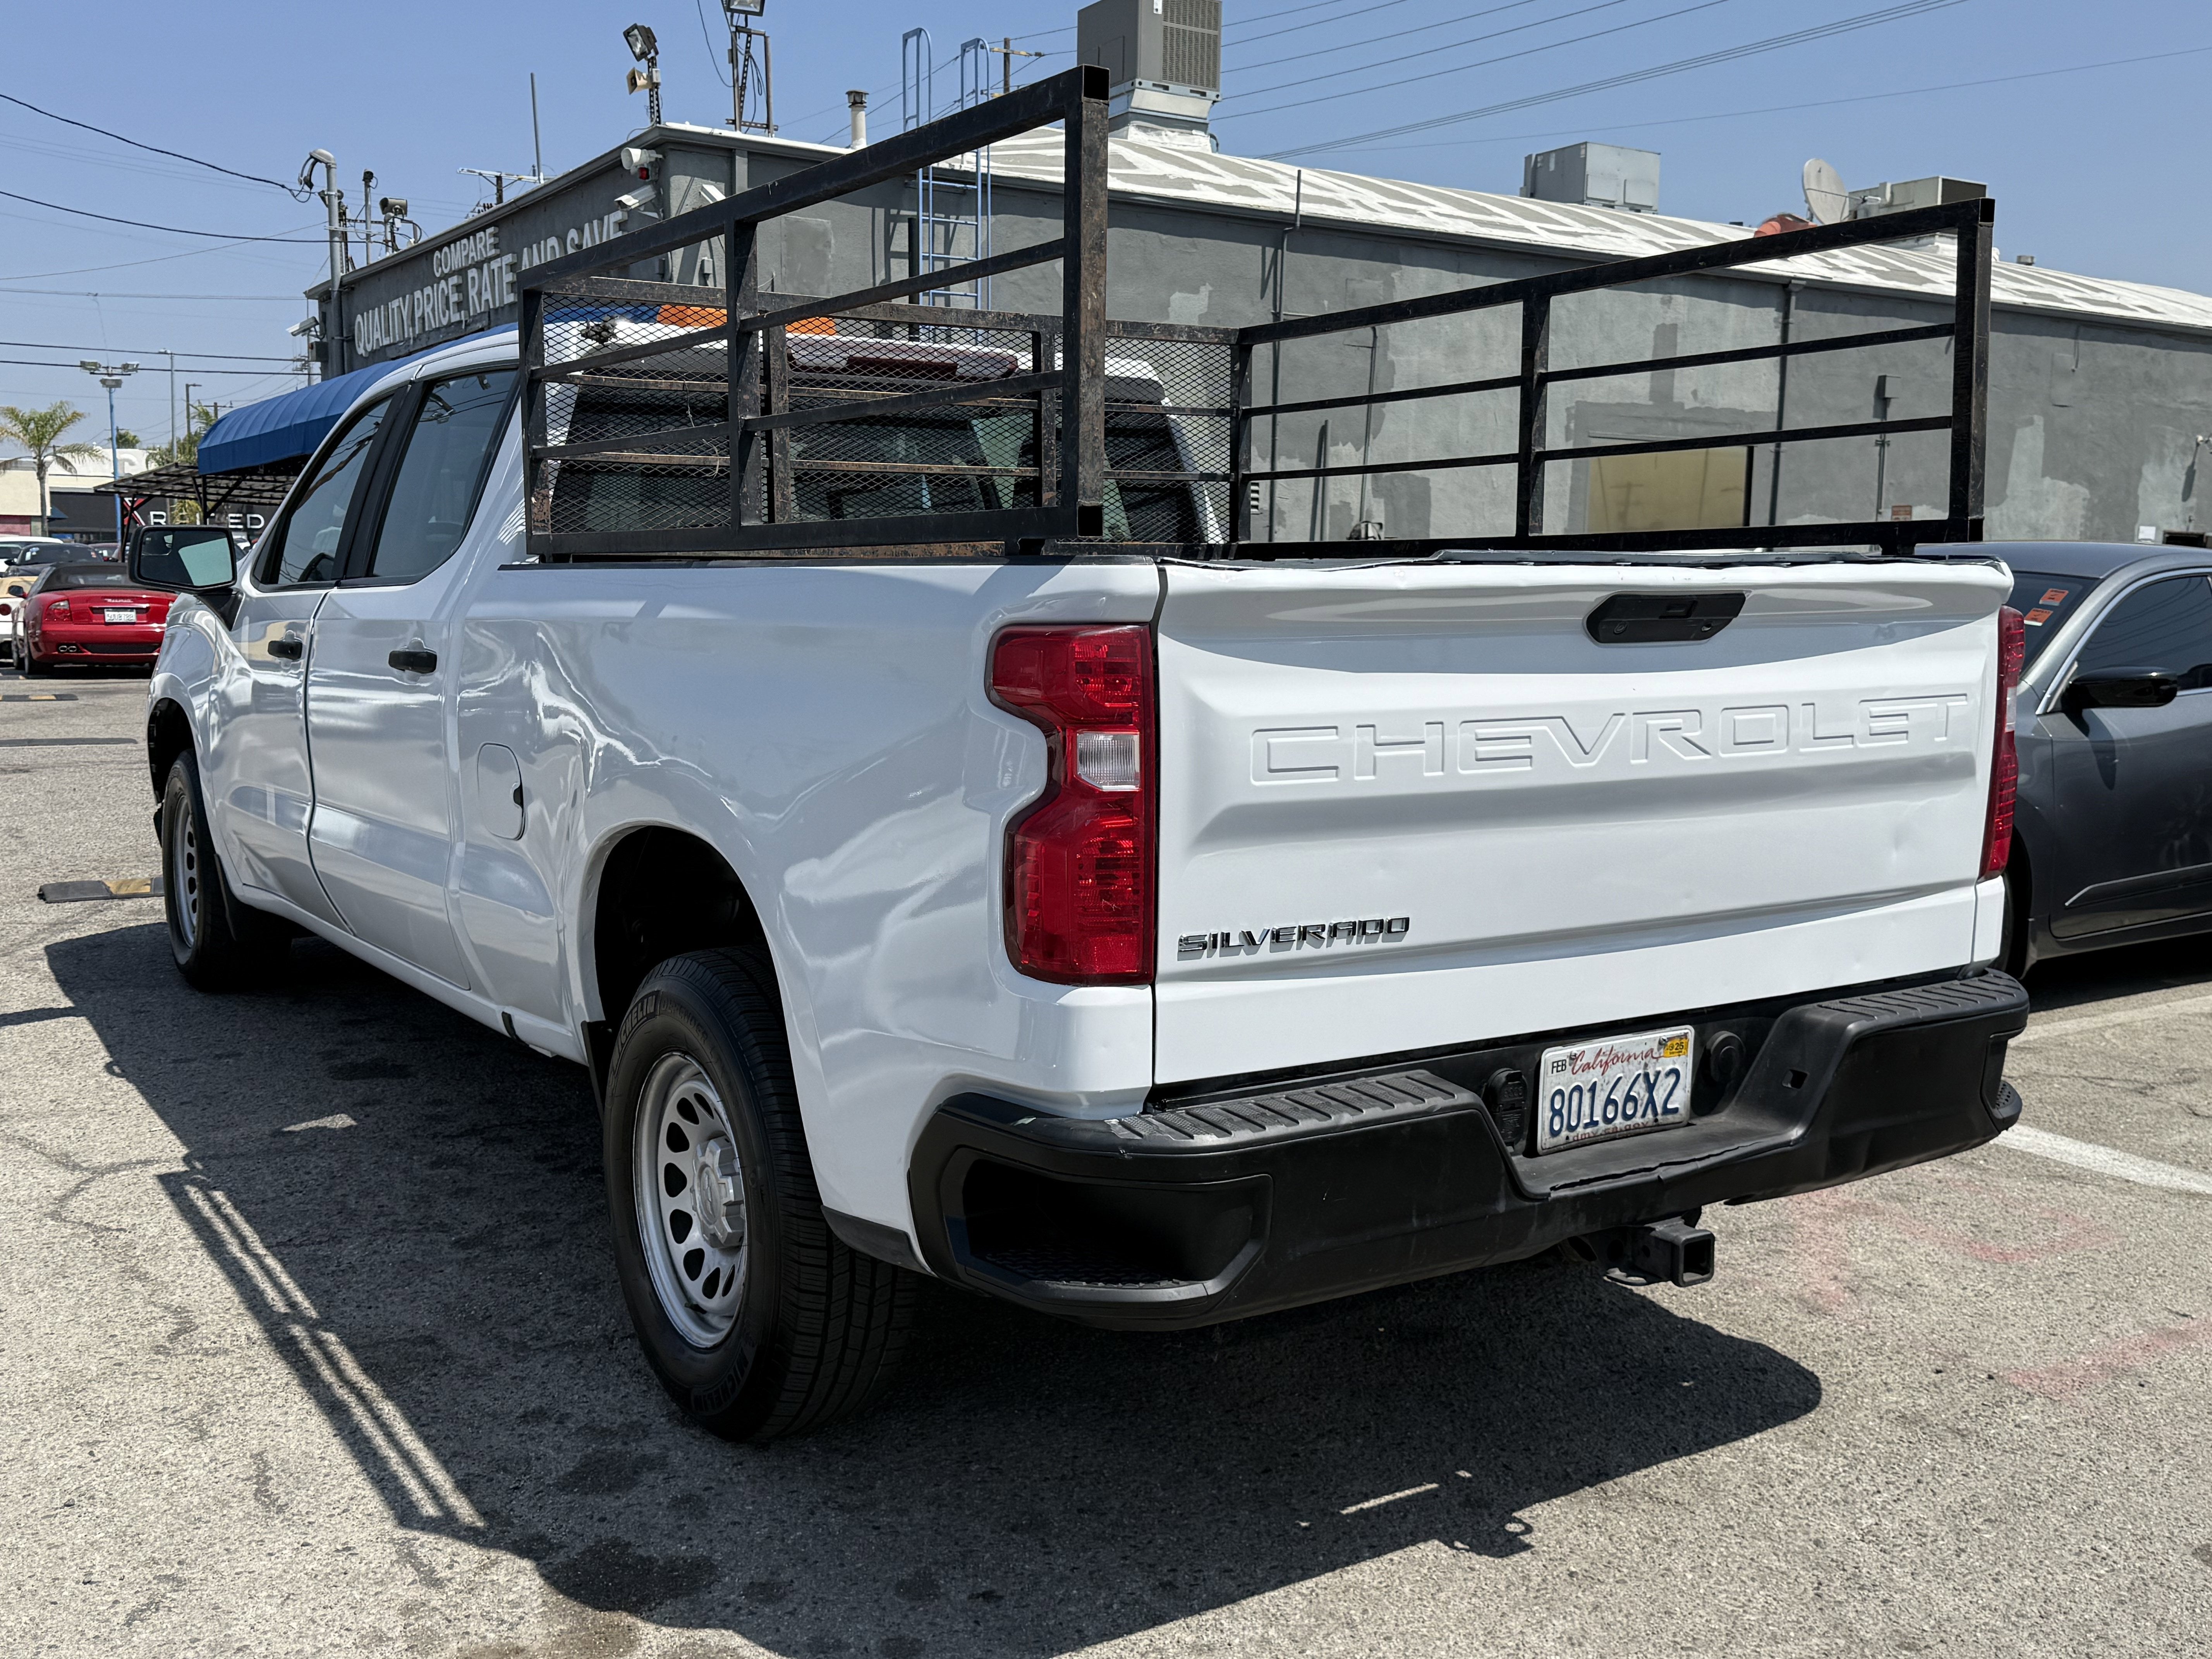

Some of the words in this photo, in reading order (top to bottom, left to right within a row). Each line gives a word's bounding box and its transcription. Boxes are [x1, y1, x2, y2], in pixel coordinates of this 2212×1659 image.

[433, 226, 500, 278] COMPARE
[467, 253, 518, 316] RATE
[566, 210, 628, 254] SAVE
[1249, 692, 1969, 786] CHEVROLET
[1177, 915, 1410, 953] SILVERADO
[1551, 1059, 1567, 1074] FEB
[1571, 1045, 1664, 1076] California
[1549, 1066, 1681, 1137] 80166X2
